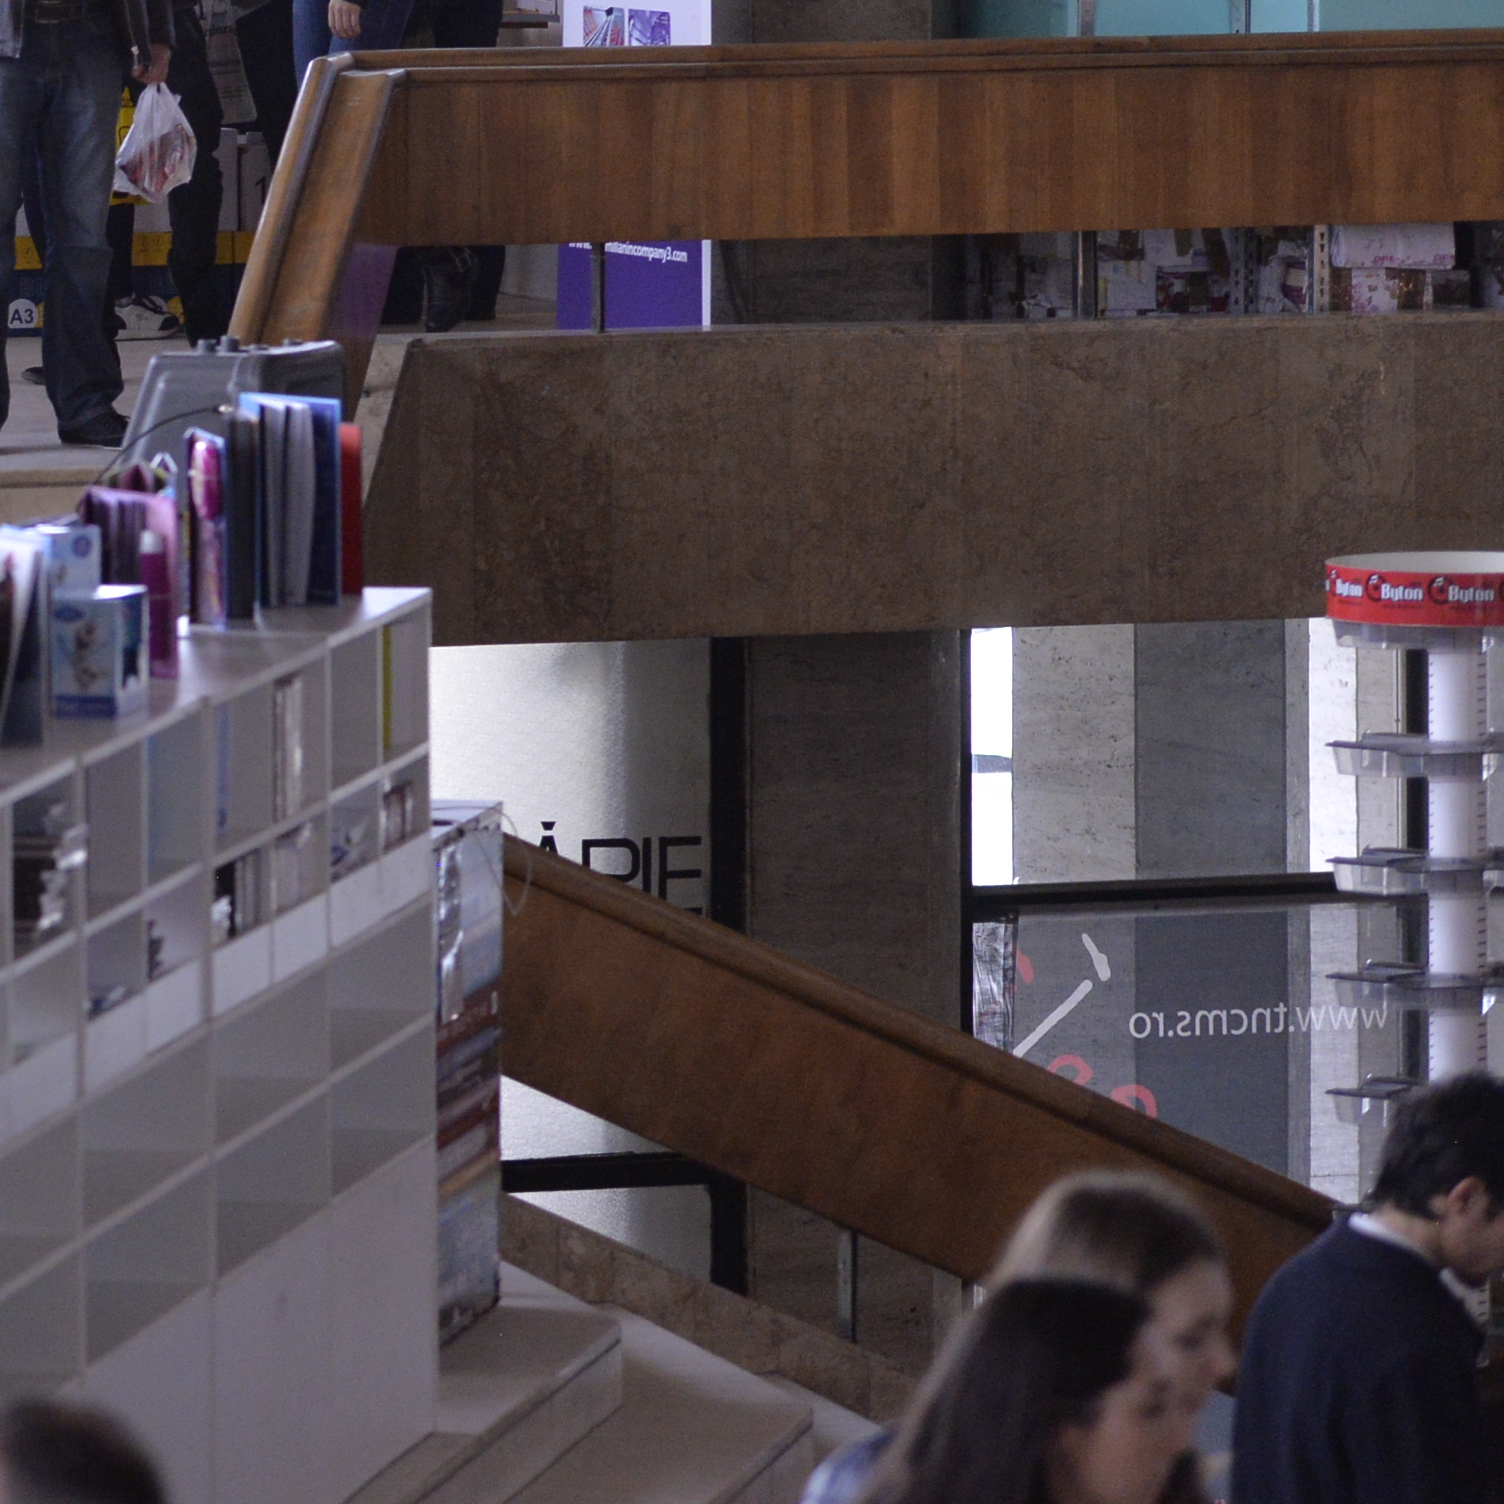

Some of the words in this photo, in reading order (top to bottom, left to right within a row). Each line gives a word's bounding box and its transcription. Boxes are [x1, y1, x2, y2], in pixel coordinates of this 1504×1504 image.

[10, 308, 34, 324] A3
[1380, 583, 1423, 601] Byton
[1447, 585, 1495, 603] Byton
